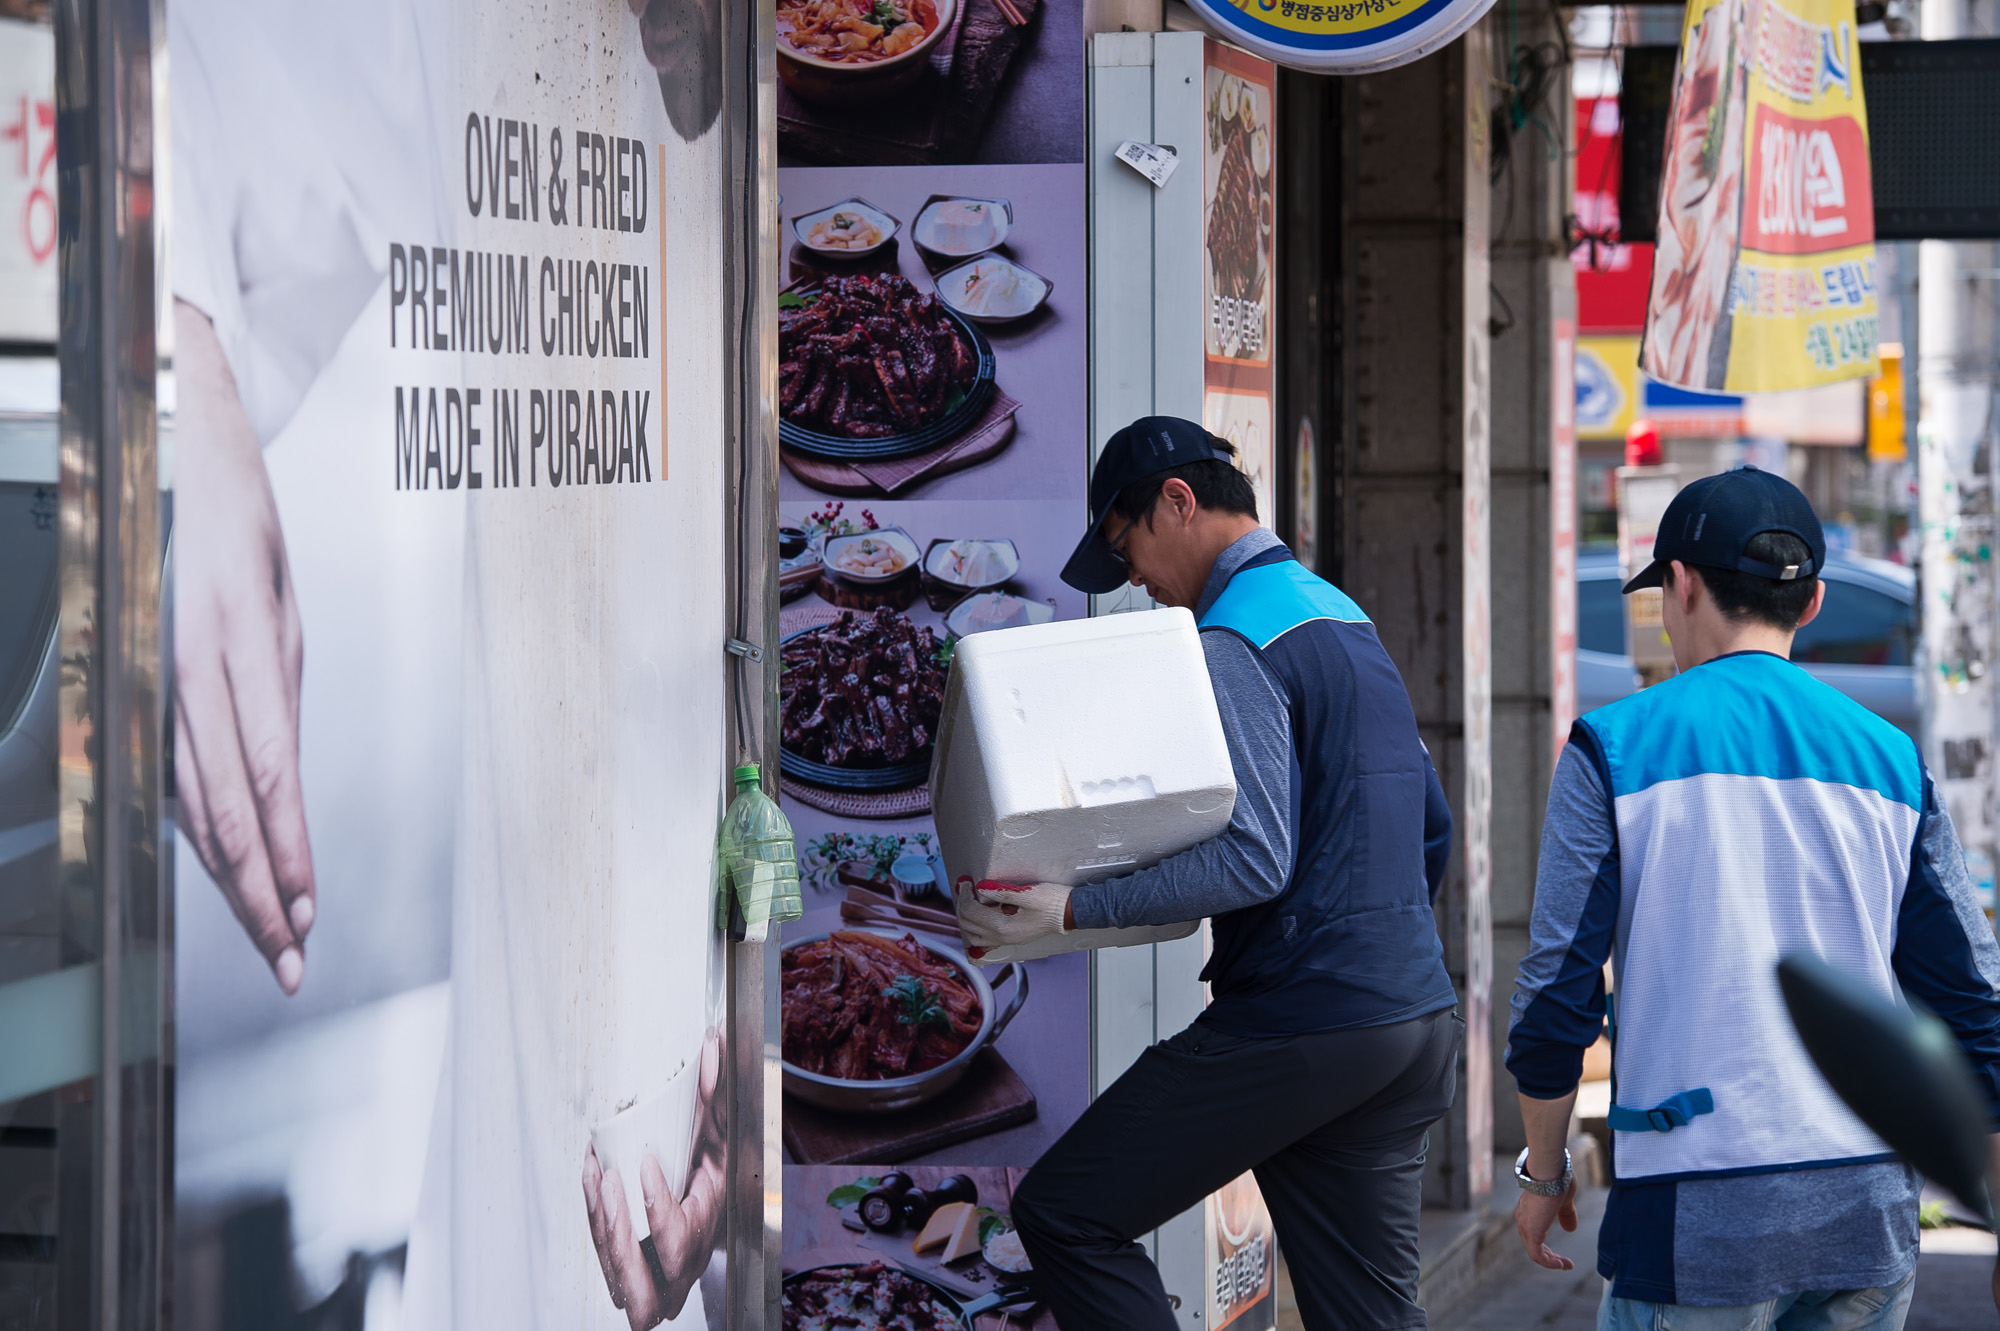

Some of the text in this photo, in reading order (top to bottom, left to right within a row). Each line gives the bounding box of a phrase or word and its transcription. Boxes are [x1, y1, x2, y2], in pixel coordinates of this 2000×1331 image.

[1281, 0, 1401, 22] 병점중심상가상
[465, 111, 649, 234] OVEN & FRIED
[390, 242, 650, 359] PREMIUM CHICKEN
[395, 386, 652, 491] MADE IN PURADAK
